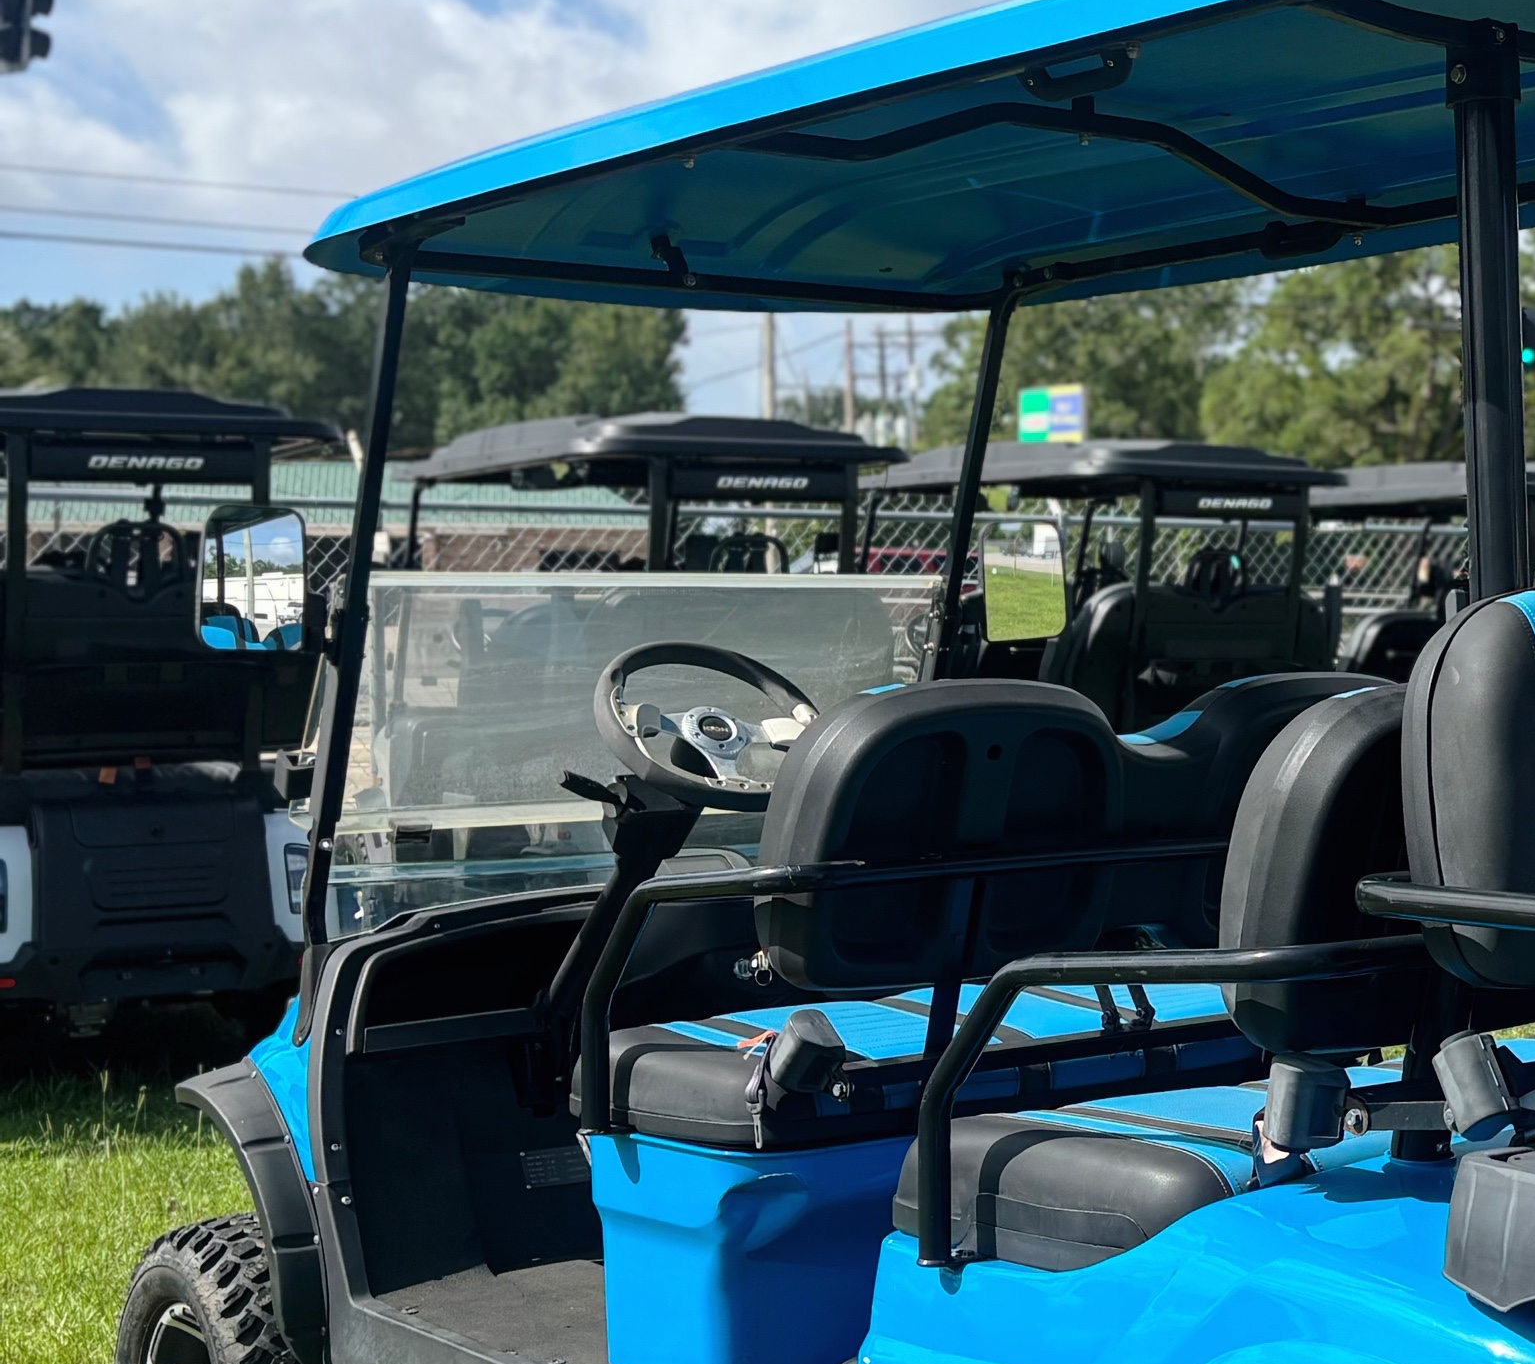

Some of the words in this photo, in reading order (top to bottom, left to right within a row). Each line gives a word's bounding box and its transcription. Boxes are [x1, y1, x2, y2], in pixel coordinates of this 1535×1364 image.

[88, 455, 204, 470] DENAGO
[716, 476, 809, 489] DENAGO
[1198, 497, 1273, 510] DENAGO
